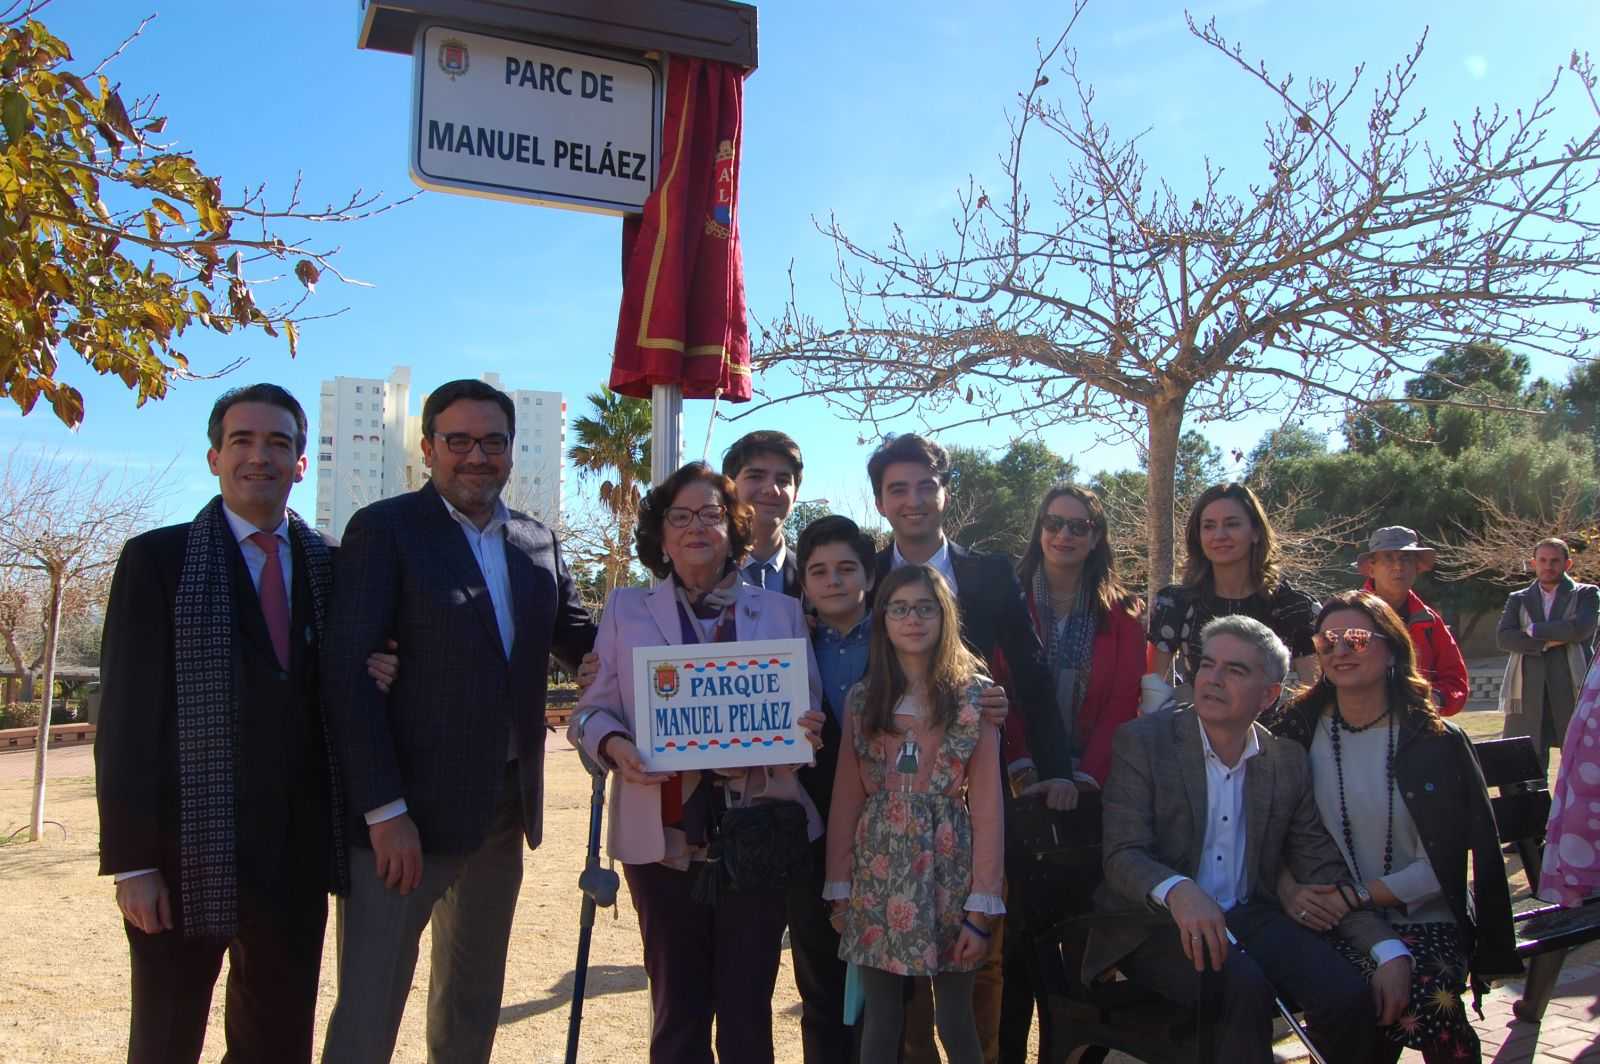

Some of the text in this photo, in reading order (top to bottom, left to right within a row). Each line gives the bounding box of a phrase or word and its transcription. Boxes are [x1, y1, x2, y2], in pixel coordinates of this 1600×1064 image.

[505, 56, 614, 103] PARC DE
[428, 119, 647, 182] MANUEL PELÁEZ
[690, 673, 780, 698] PARQUE
[655, 699, 792, 736] MANUEL PELÁEZ
